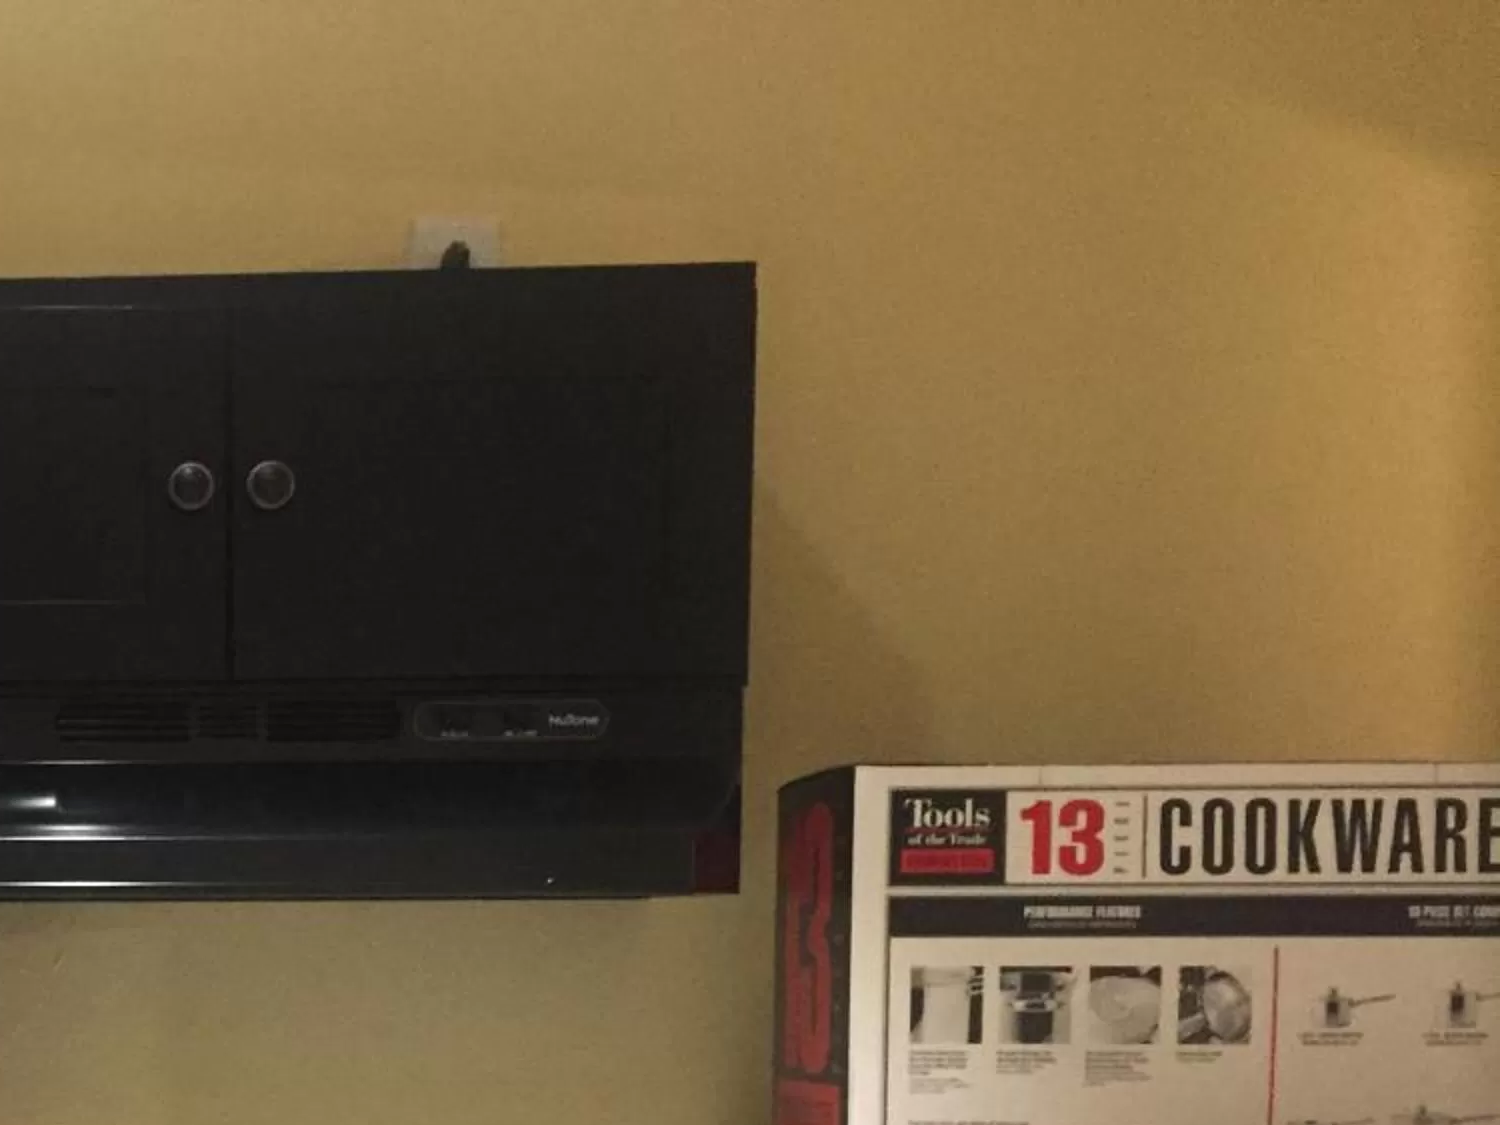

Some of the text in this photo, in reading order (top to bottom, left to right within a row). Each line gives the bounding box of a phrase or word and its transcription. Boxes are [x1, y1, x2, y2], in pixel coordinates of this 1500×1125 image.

[904, 798, 992, 829] Tools
[907, 832, 987, 846] of the Trade
[1020, 799, 1105, 876] 13
[1159, 797, 1500, 876] COOKWARE
